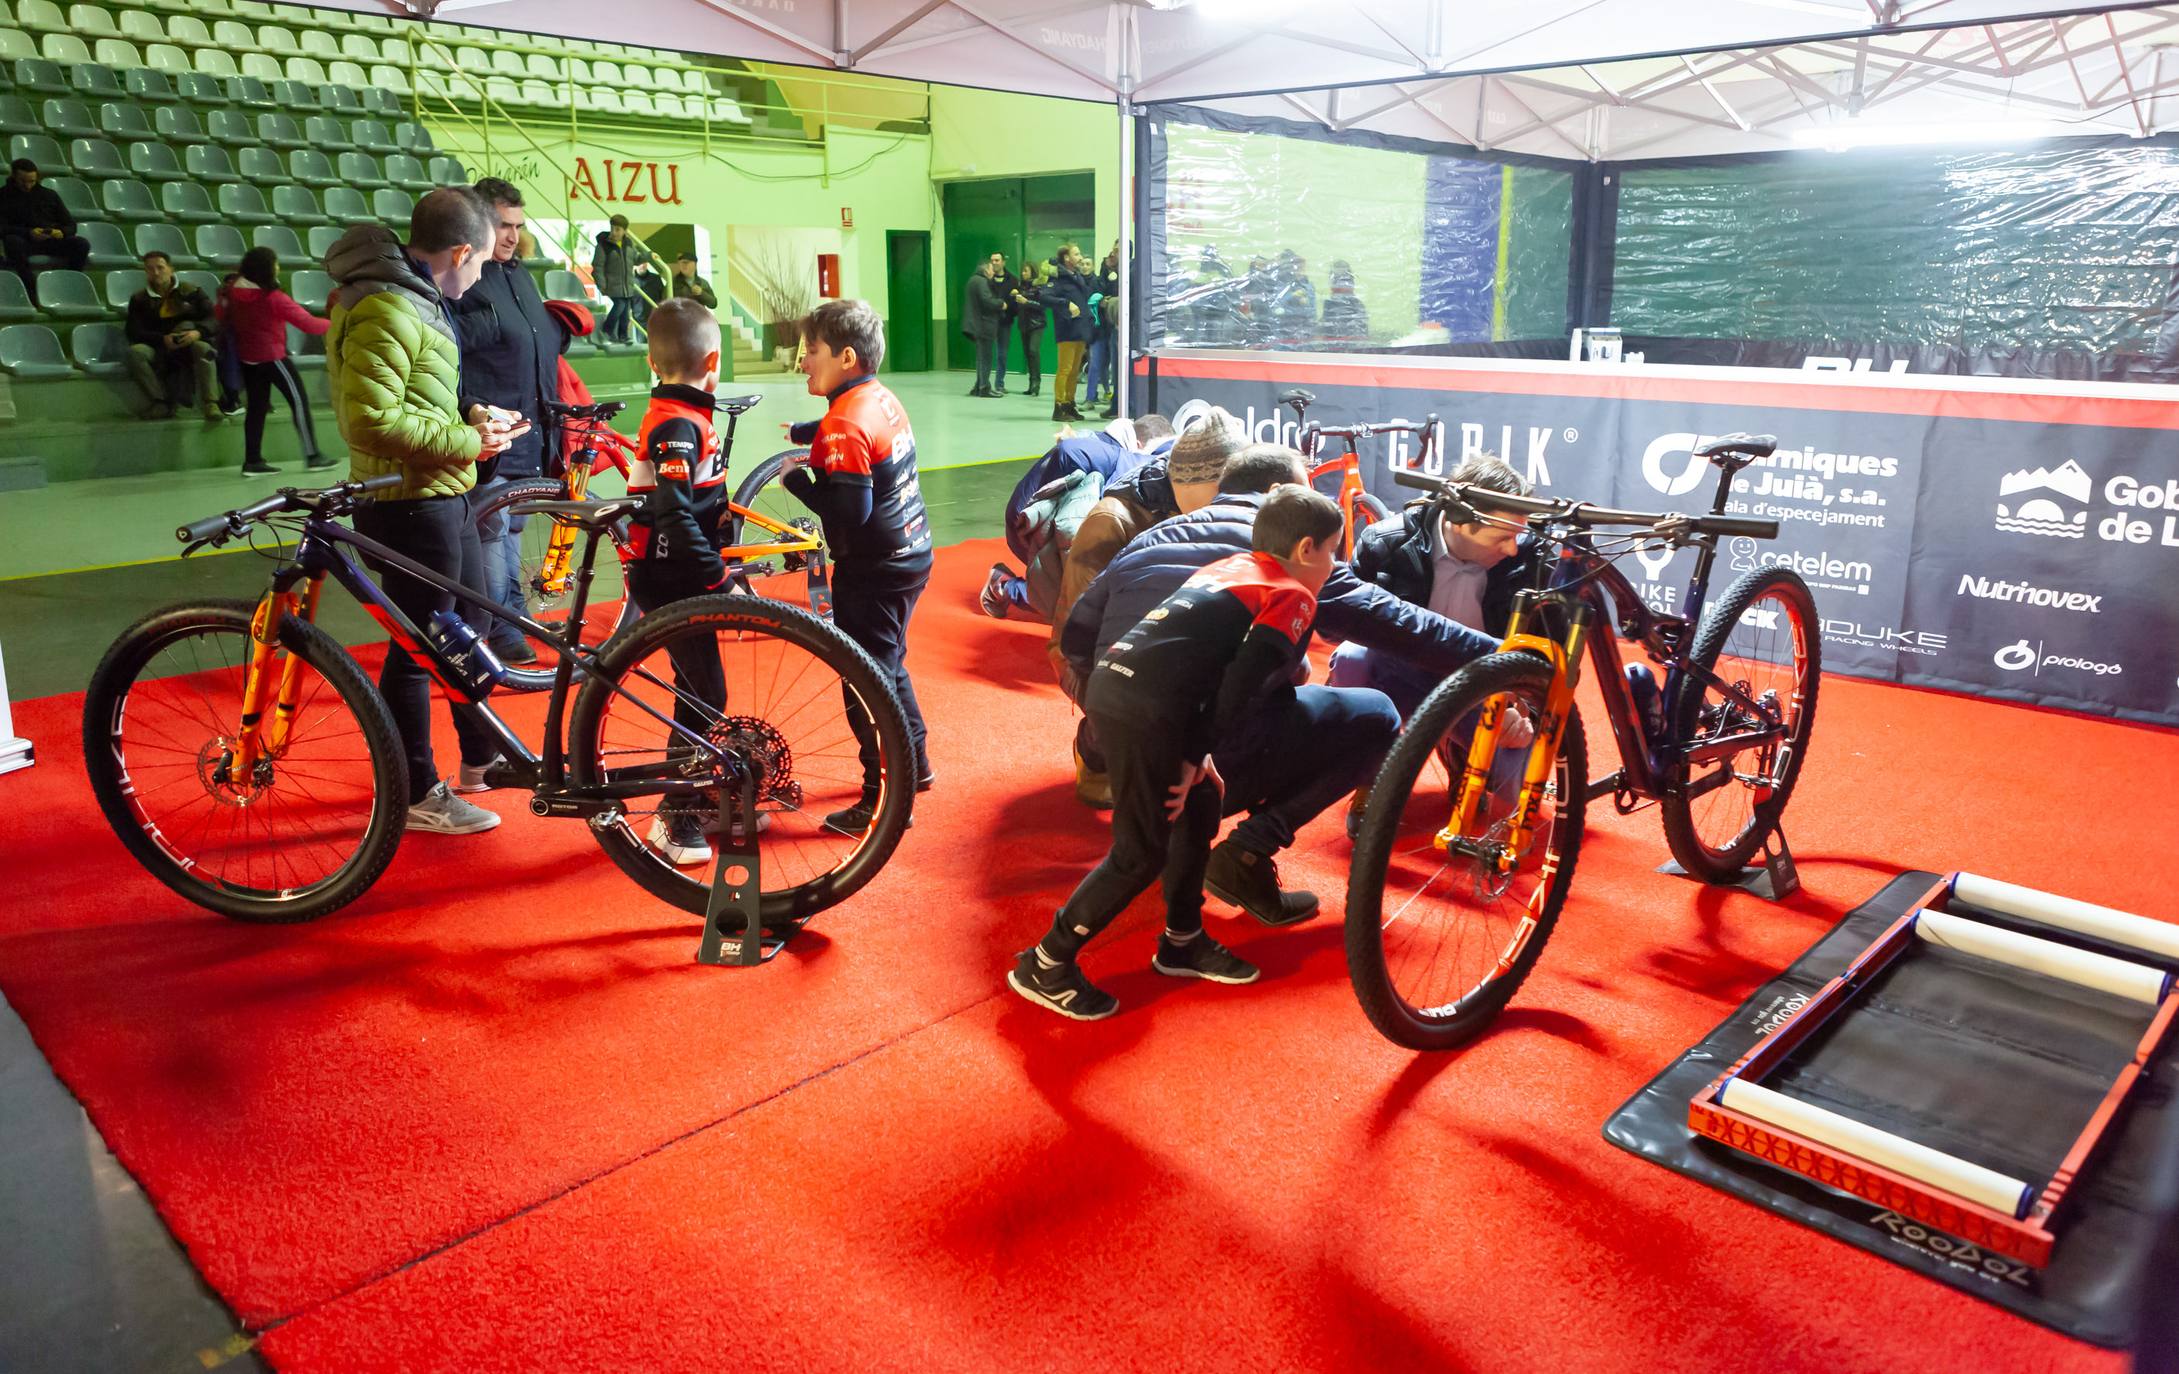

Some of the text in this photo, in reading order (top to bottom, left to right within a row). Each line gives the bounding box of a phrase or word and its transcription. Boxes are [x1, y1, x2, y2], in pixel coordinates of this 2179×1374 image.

[569, 157, 684, 206] AIZU
[1753, 472, 1835, 505] Juià,
[1839, 487, 1886, 506] s.a.
[1723, 501, 1885, 528] ala d'especejament
[2098, 512, 2152, 544] de
[1761, 552, 1872, 581] cetelem
[1631, 582, 1676, 603] IKE
[1958, 574, 2103, 613] Nutrinovex
[688, 613, 782, 628] PHANTOM
[1824, 635, 1938, 656] RACING WHEELS
[2043, 655, 2122, 675] prologo
